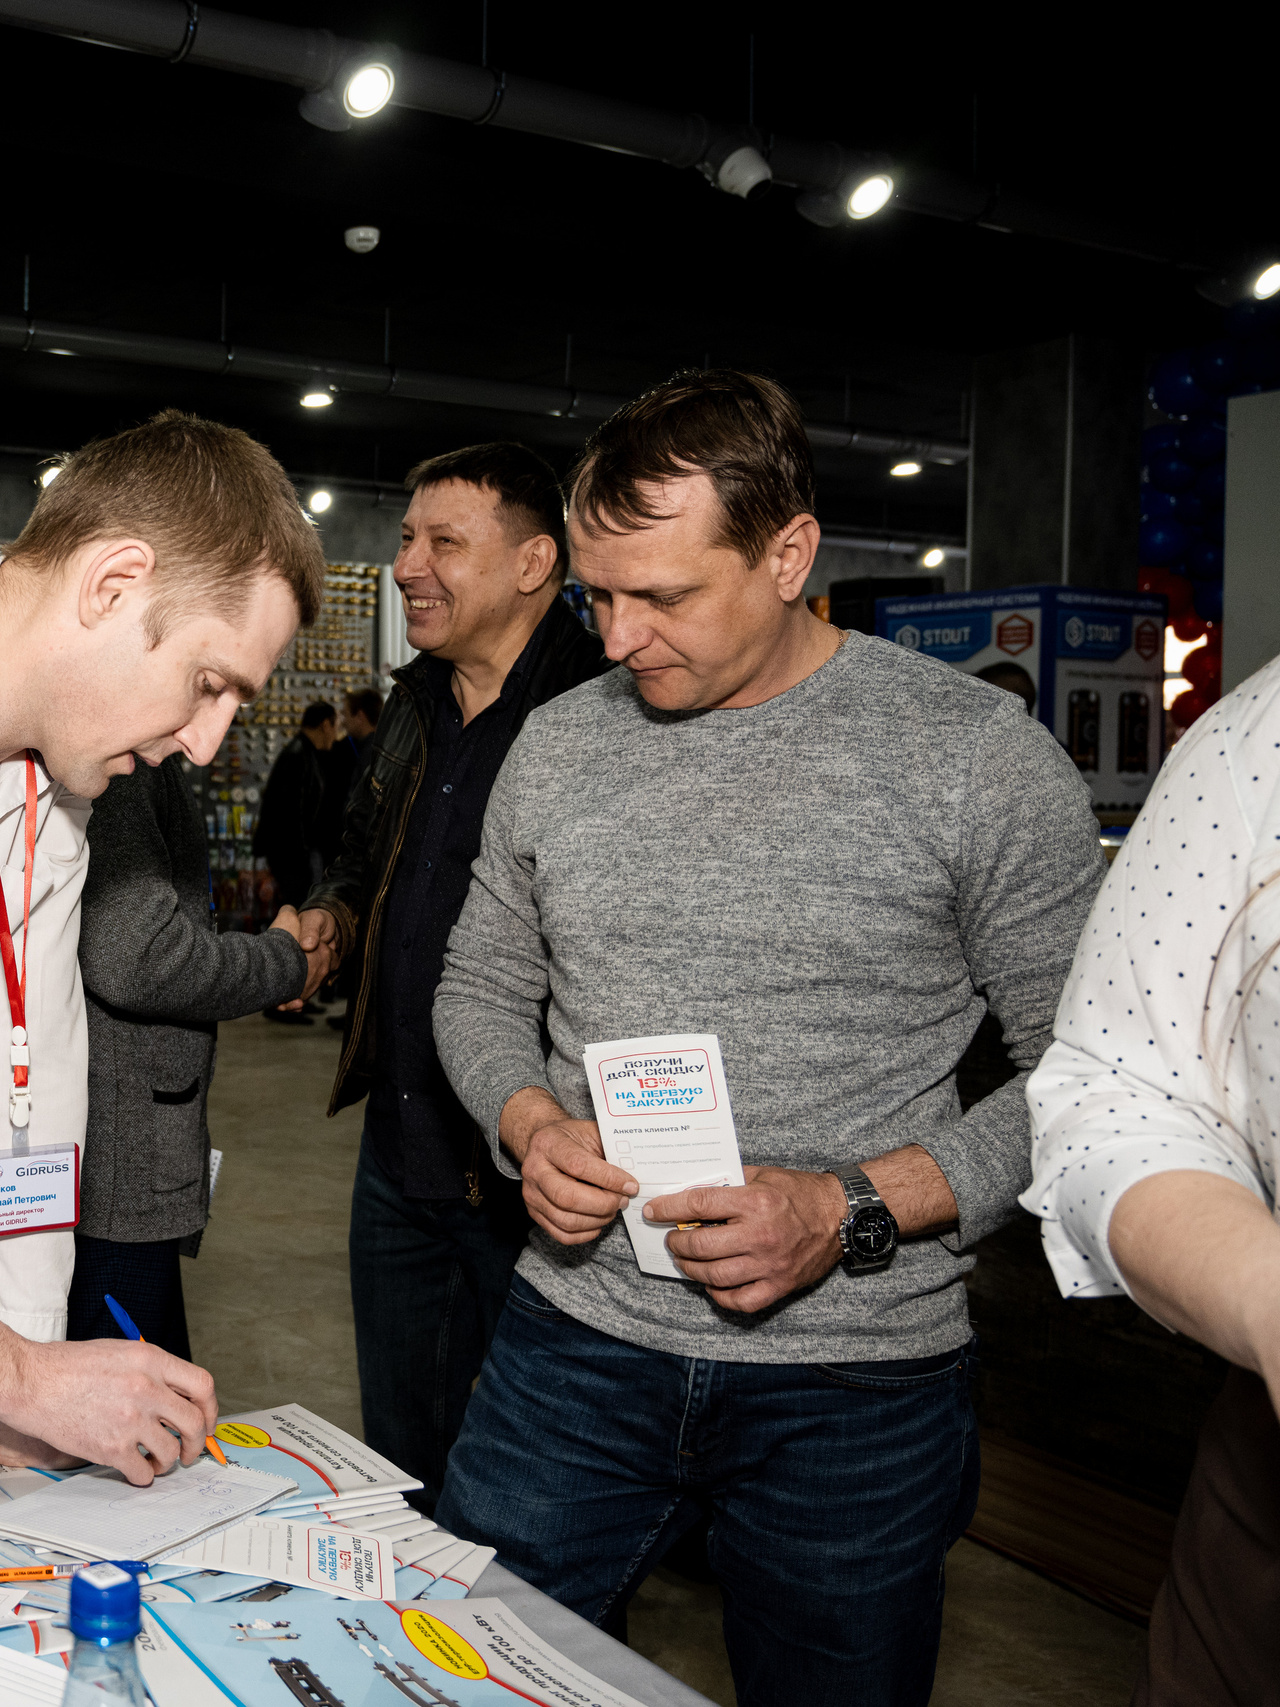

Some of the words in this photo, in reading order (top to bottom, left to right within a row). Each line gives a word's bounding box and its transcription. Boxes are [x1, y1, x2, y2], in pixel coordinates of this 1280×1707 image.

[923, 626, 972, 647] STOUT
[1086, 624, 1121, 642] STOUT
[624, 1057, 683, 1069] ПОЛУЧИ
[606, 1069, 639, 1082] ДОП.
[645, 1064, 705, 1076] СКИДКУ
[637, 1077, 677, 1089] 10%
[615, 1091, 635, 1100] НА
[641, 1087, 703, 1098] ПЕРВУЮ
[626, 1096, 695, 1108] ЗАКУПКУ
[16, 1163, 69, 1177] GIDRUSS
[14, 1193, 57, 1205] Петрович
[15, 1207, 45, 1216] директор
[5, 1218, 28, 1226] GIDRUS
[271, 1414, 285, 1423] кВт
[283, 1421, 298, 1430] 100
[277, 1426, 315, 1449] продукции
[307, 1434, 342, 1457] сегмента
[315, 1449, 344, 1470] Каталог
[341, 1457, 377, 1483] бытового
[327, 1535, 337, 1546] НА
[317, 1537, 327, 1574] ЗАКУПКУ
[328, 1547, 338, 1581] ПЕРВУЮ
[339, 1549, 352, 1571] 10%
[354, 1556, 365, 1592] СКИДКУ
[364, 1549, 374, 1584] ПОЛУЧИ
[413, 1621, 433, 1639] 2020
[472, 1613, 496, 1633] кВт
[492, 1635, 516, 1652] 100
[430, 1639, 463, 1670] НОВИНКА
[517, 1655, 536, 1666] до
[487, 1643, 550, 1689] продукции
[533, 1667, 591, 1702] сегмента
